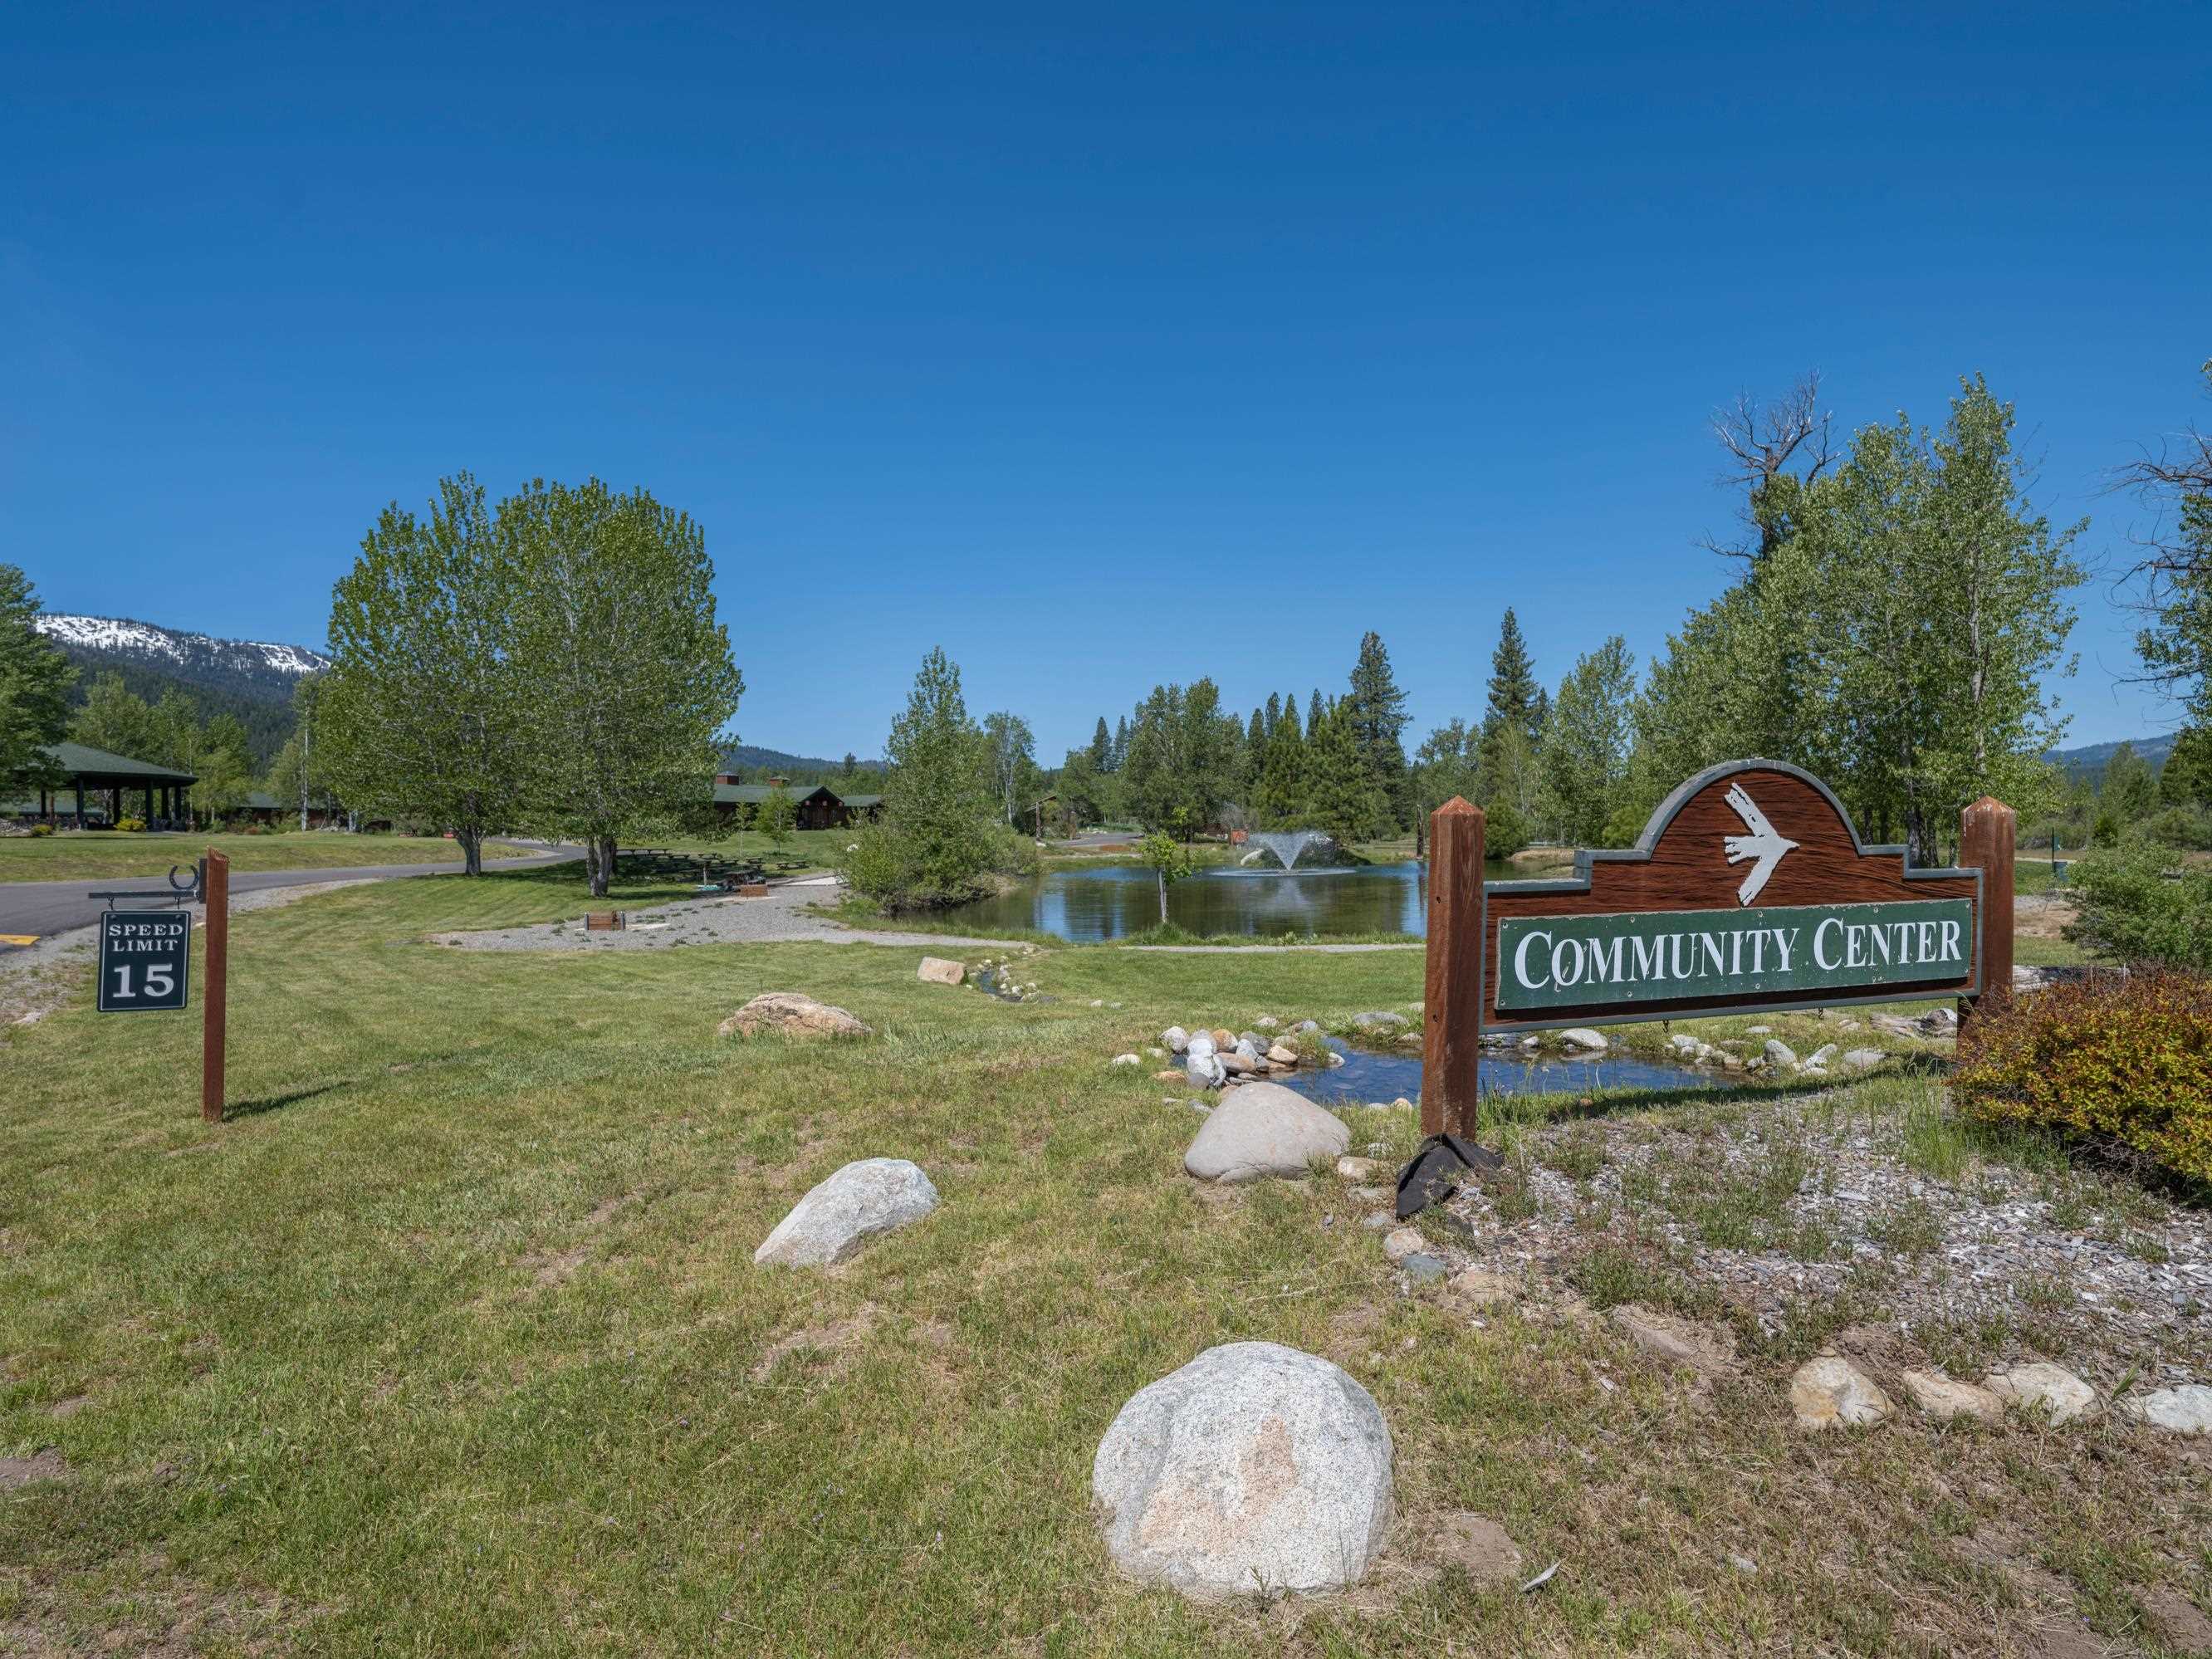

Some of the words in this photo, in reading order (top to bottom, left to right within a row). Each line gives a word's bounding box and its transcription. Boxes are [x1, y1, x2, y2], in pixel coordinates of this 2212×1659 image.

[109, 923, 183, 936] SPEED
[113, 939, 178, 952] LIMIT
[1514, 927, 1799, 989] COMMUNITY
[1813, 918, 1962, 970] CENTER
[113, 963, 174, 997] 15
